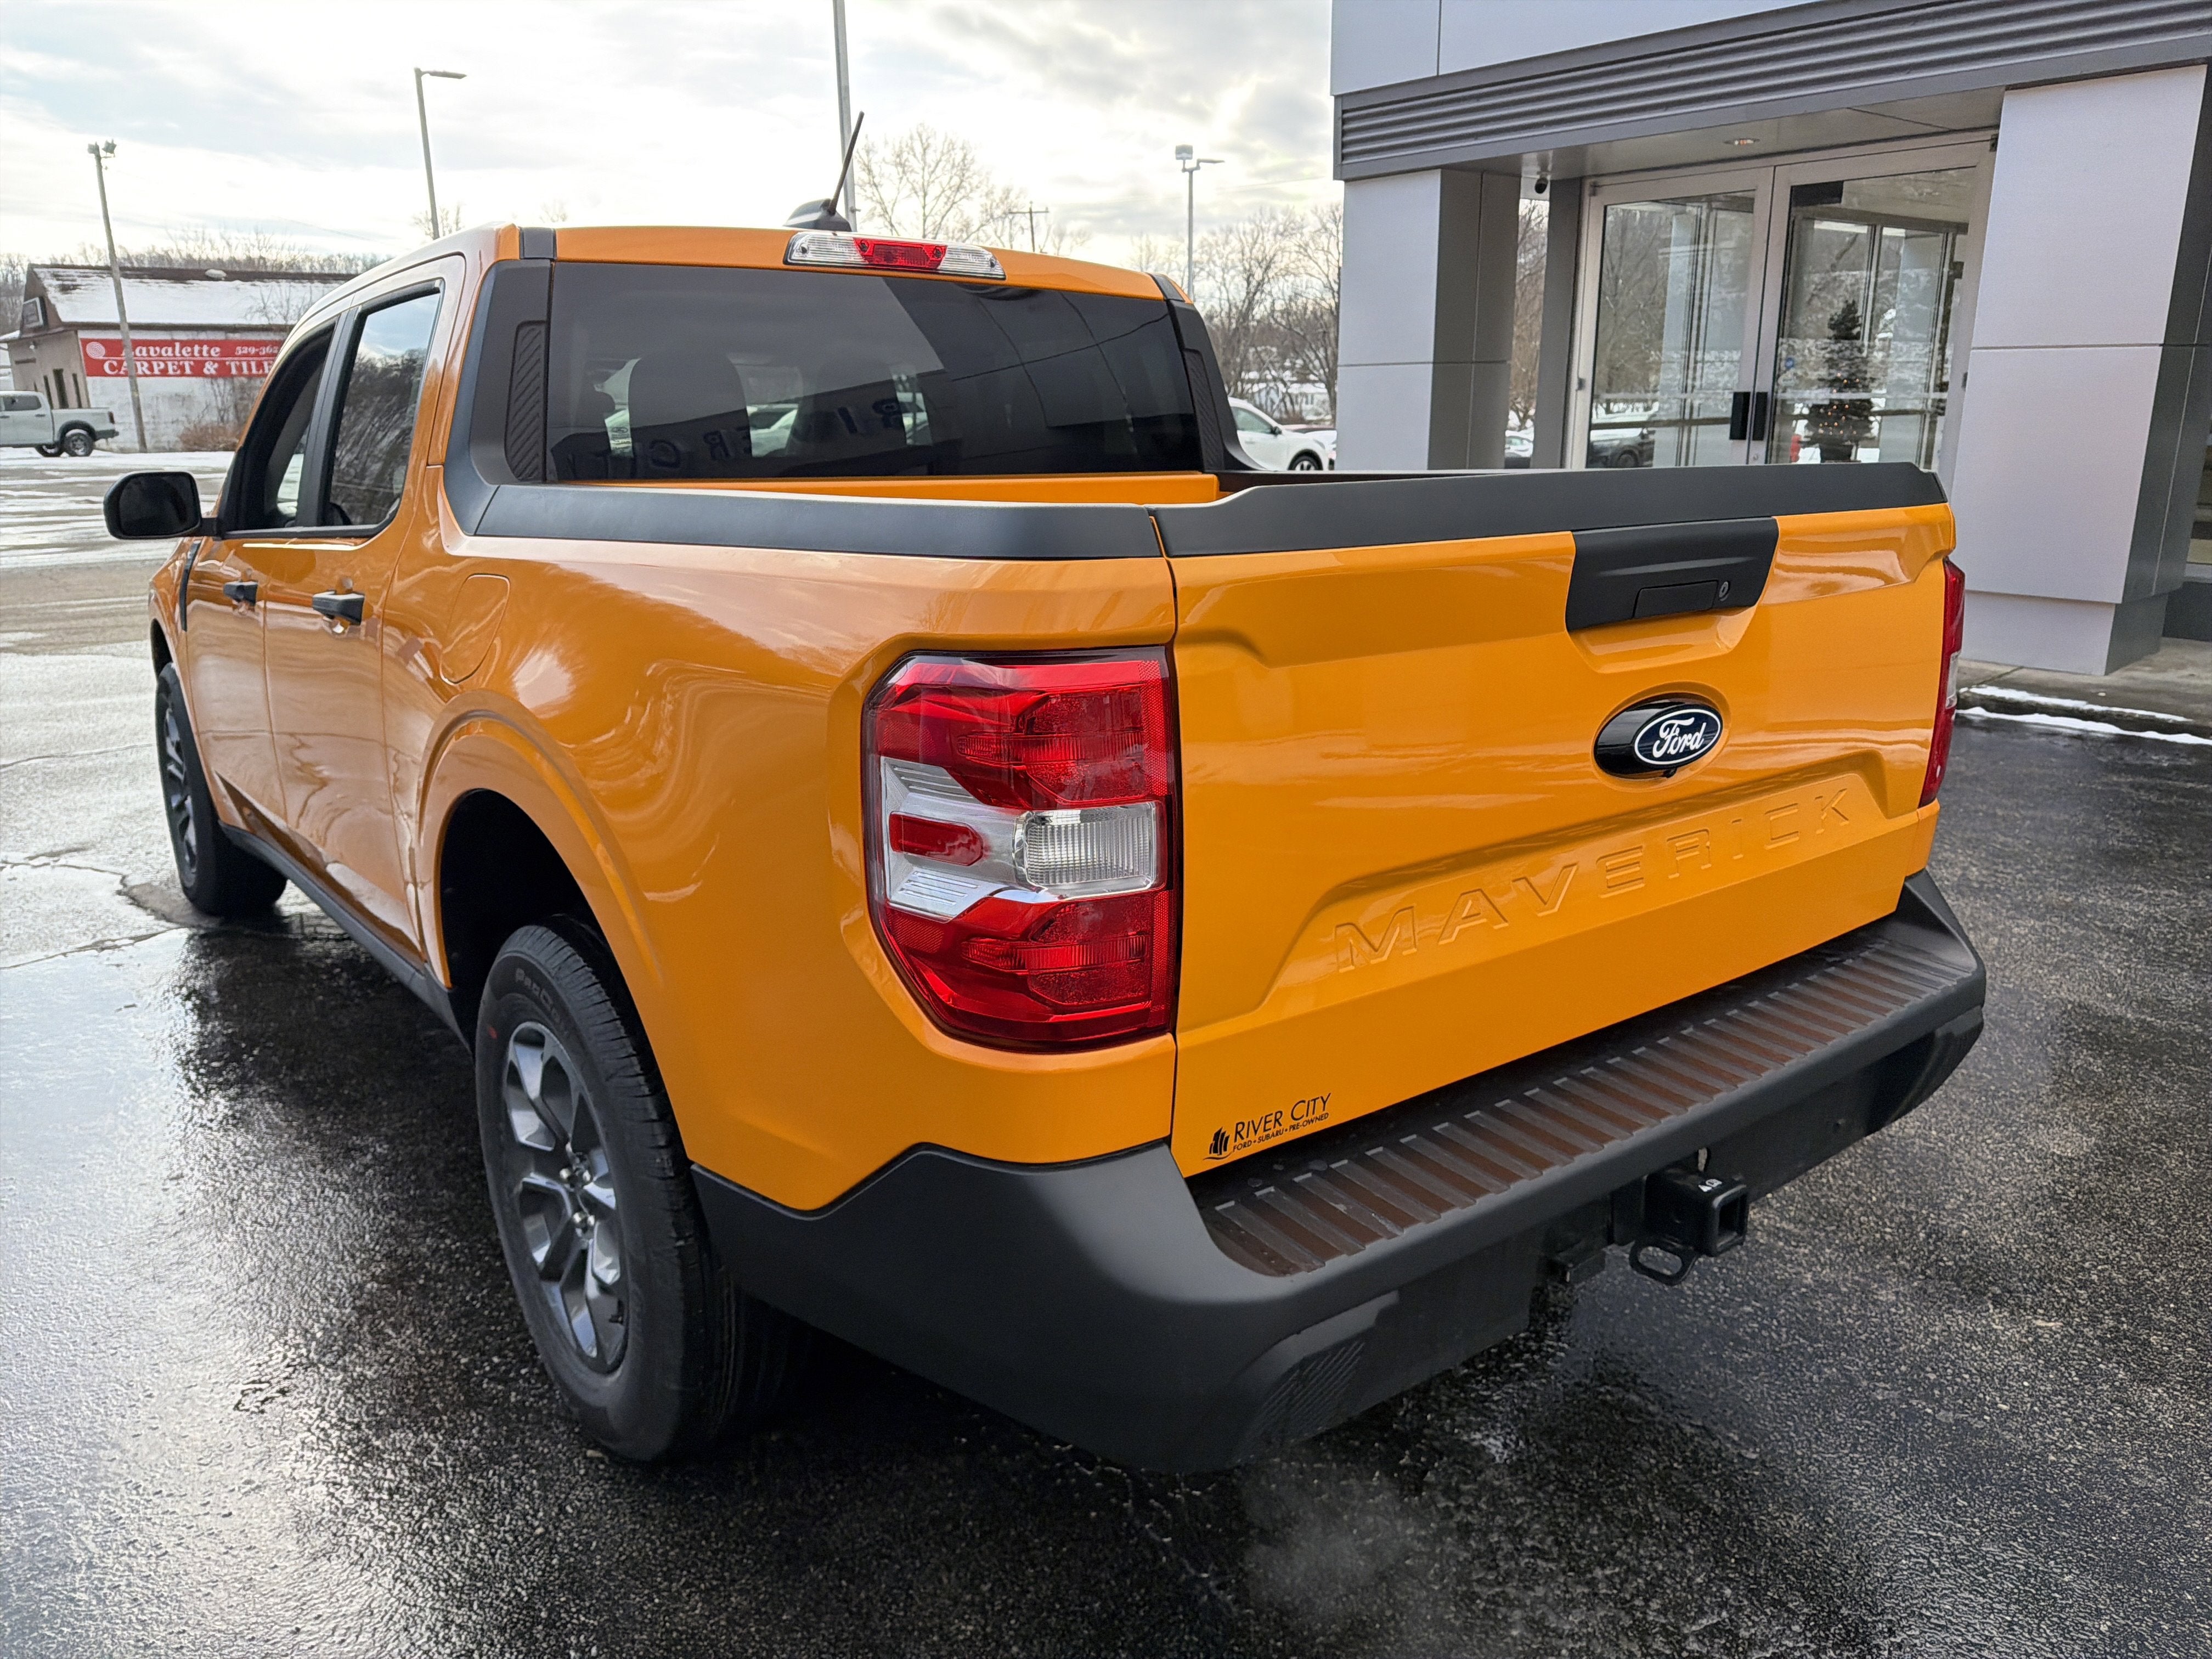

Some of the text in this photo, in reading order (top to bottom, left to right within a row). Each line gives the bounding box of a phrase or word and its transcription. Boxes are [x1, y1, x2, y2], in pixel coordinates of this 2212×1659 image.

[121, 342, 279, 357] avalette 529-362
[203, 360, 219, 375] &
[1652, 717, 1707, 758] Ford
[1334, 788, 1852, 973] MAVERICK
[1233, 1112, 1329, 1152] FORD SUBARU PRE-OWNED
[1234, 1092, 1332, 1143] RIVER CITY
